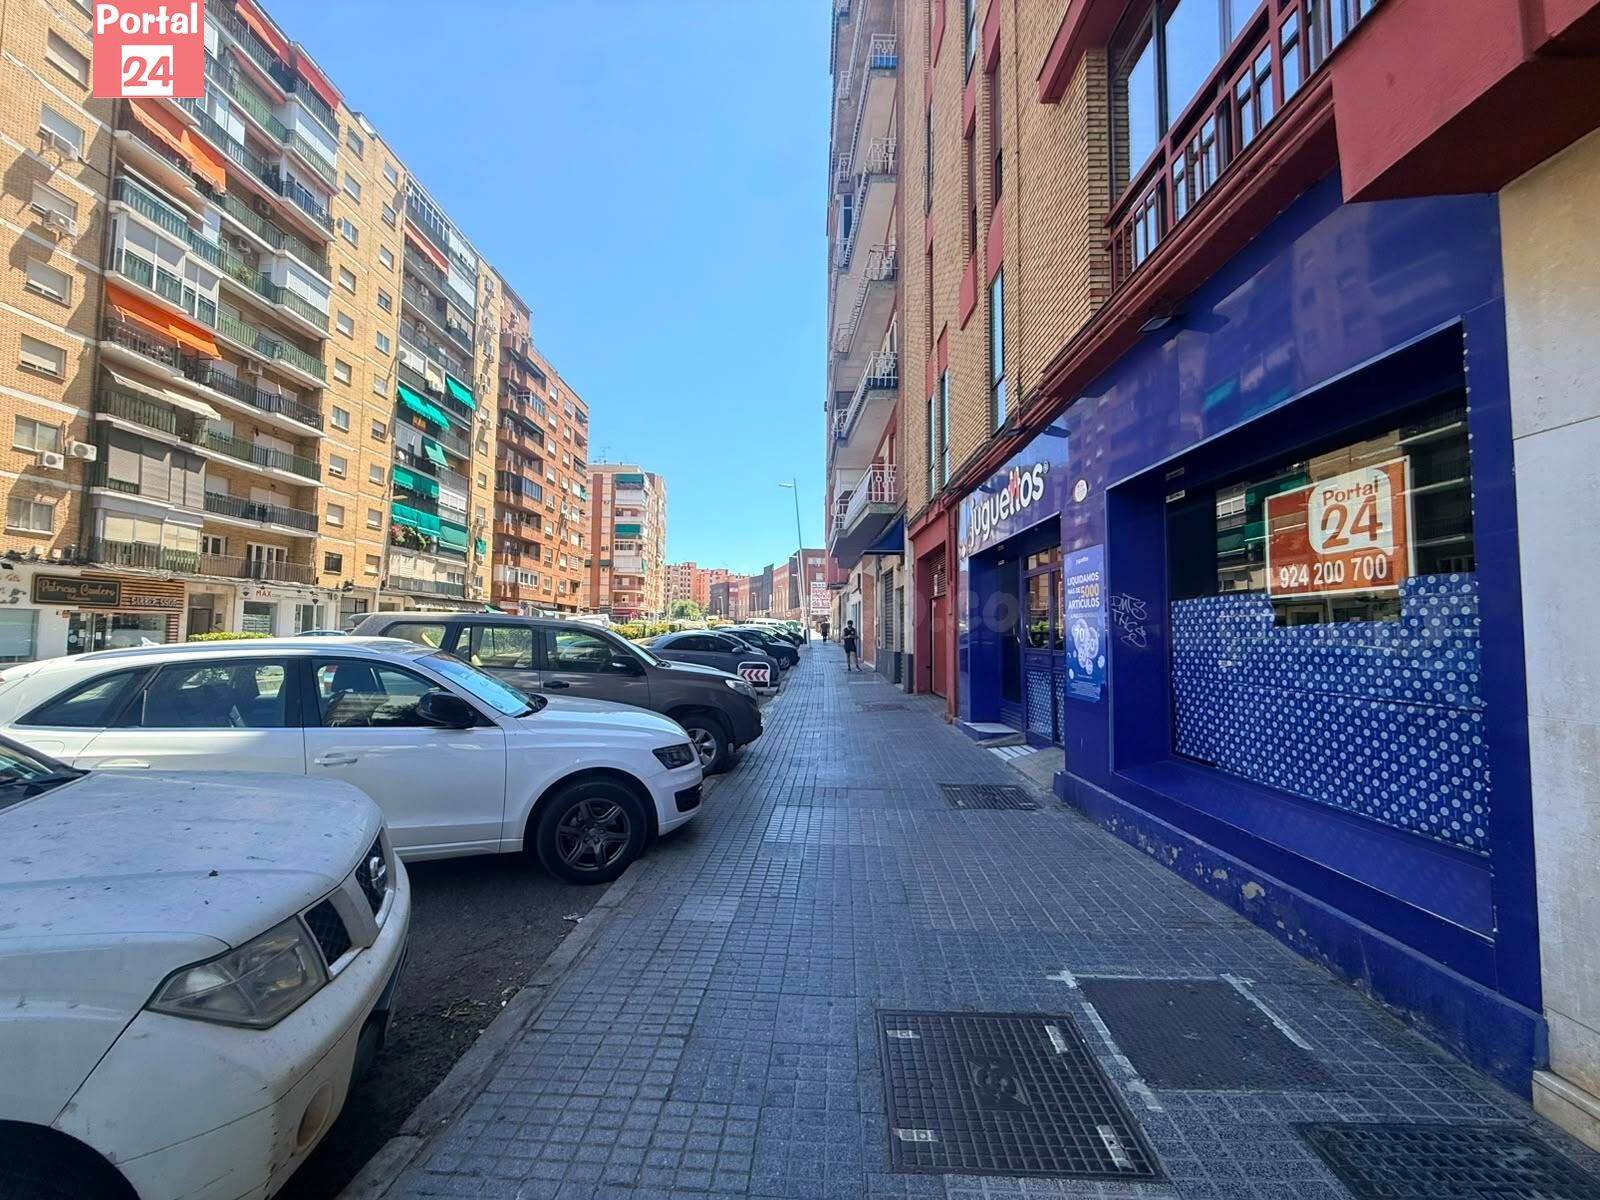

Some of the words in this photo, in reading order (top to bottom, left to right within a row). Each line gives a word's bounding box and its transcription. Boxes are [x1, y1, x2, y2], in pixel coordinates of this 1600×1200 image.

[1323, 476, 1379, 506] Portal
[969, 463, 1045, 547] juguettos
[1320, 494, 1383, 549] 24
[1067, 571, 1100, 586] LIQUIDAMOS
[1279, 563, 1309, 589] 924
[1313, 559, 1345, 585] 200
[1351, 554, 1387, 582] 700
[255, 589, 273, 598] MAX
[1080, 583, 1100, 598] 5000
[1068, 595, 1100, 610] ARTÍCULOS
